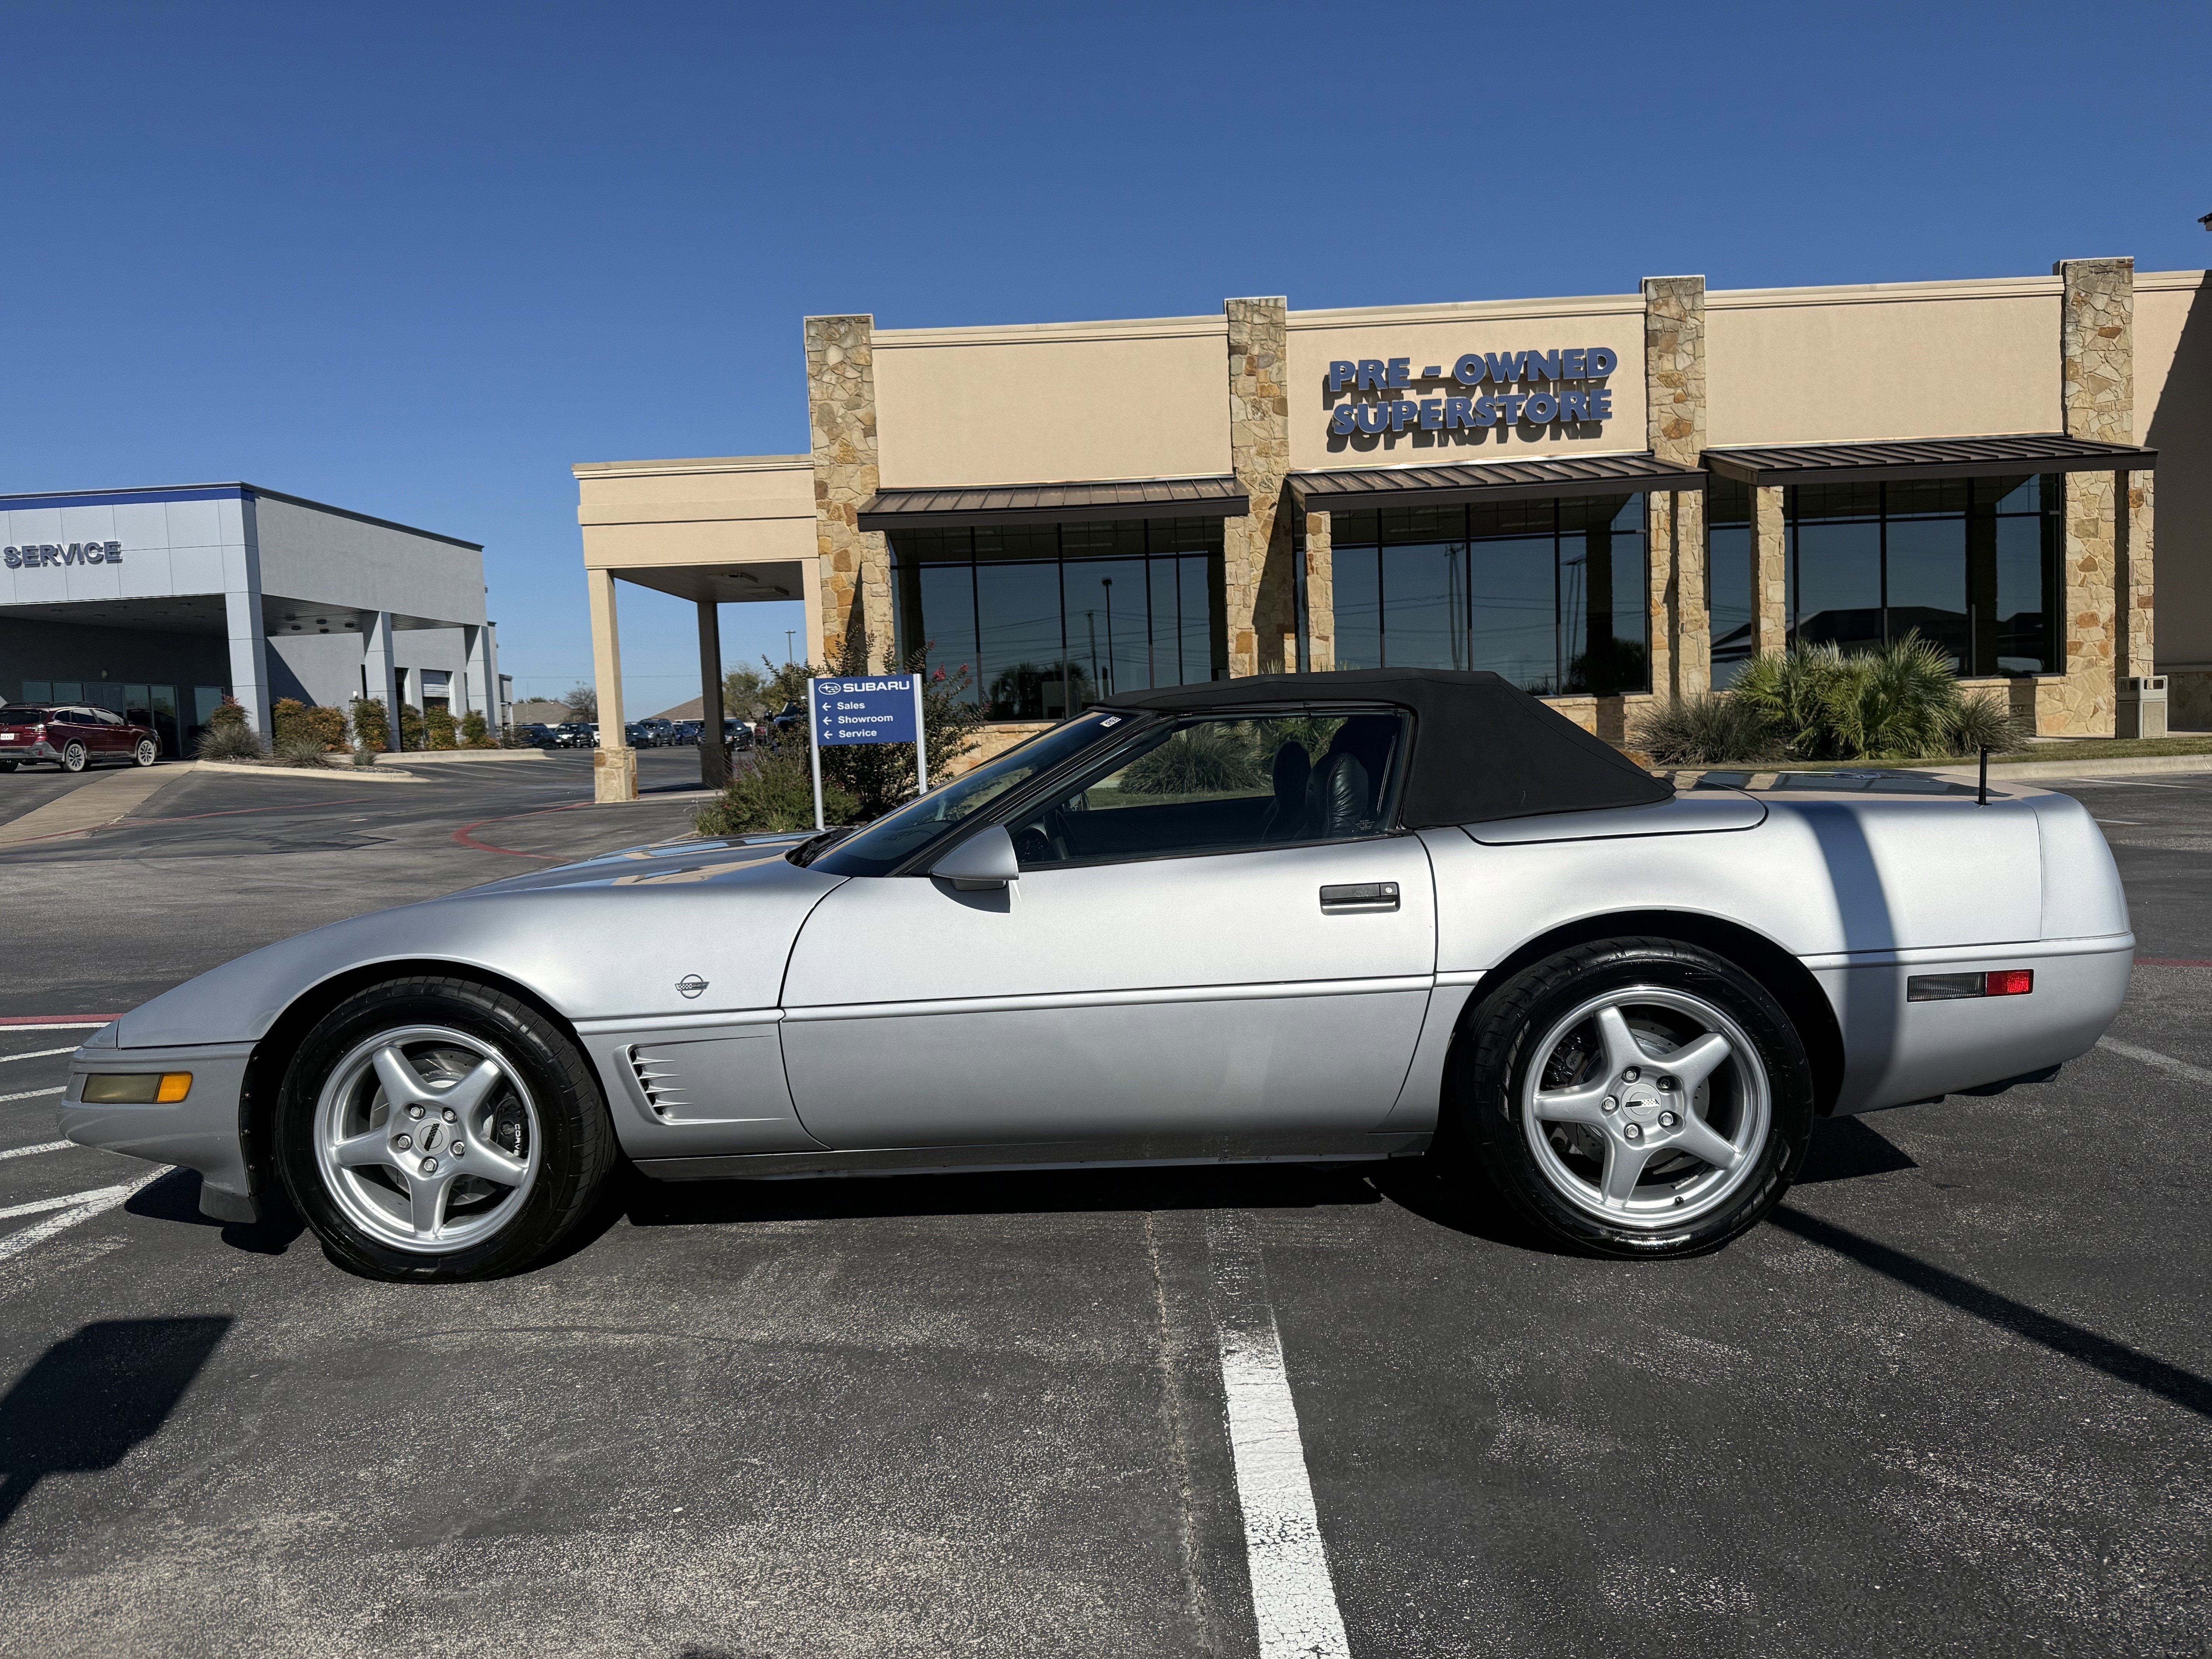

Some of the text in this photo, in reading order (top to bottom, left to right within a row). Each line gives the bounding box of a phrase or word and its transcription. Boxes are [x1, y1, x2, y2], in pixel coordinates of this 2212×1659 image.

[1329, 357, 1410, 392] PRE
[1454, 347, 1618, 385] OWNED
[1333, 389, 1613, 435] SUPERSTORE
[3, 541, 122, 568] SERVICE
[843, 681, 910, 692] SUBARU
[837, 702, 865, 710] Sales
[838, 714, 893, 724] Showroom
[839, 729, 877, 738] Service
